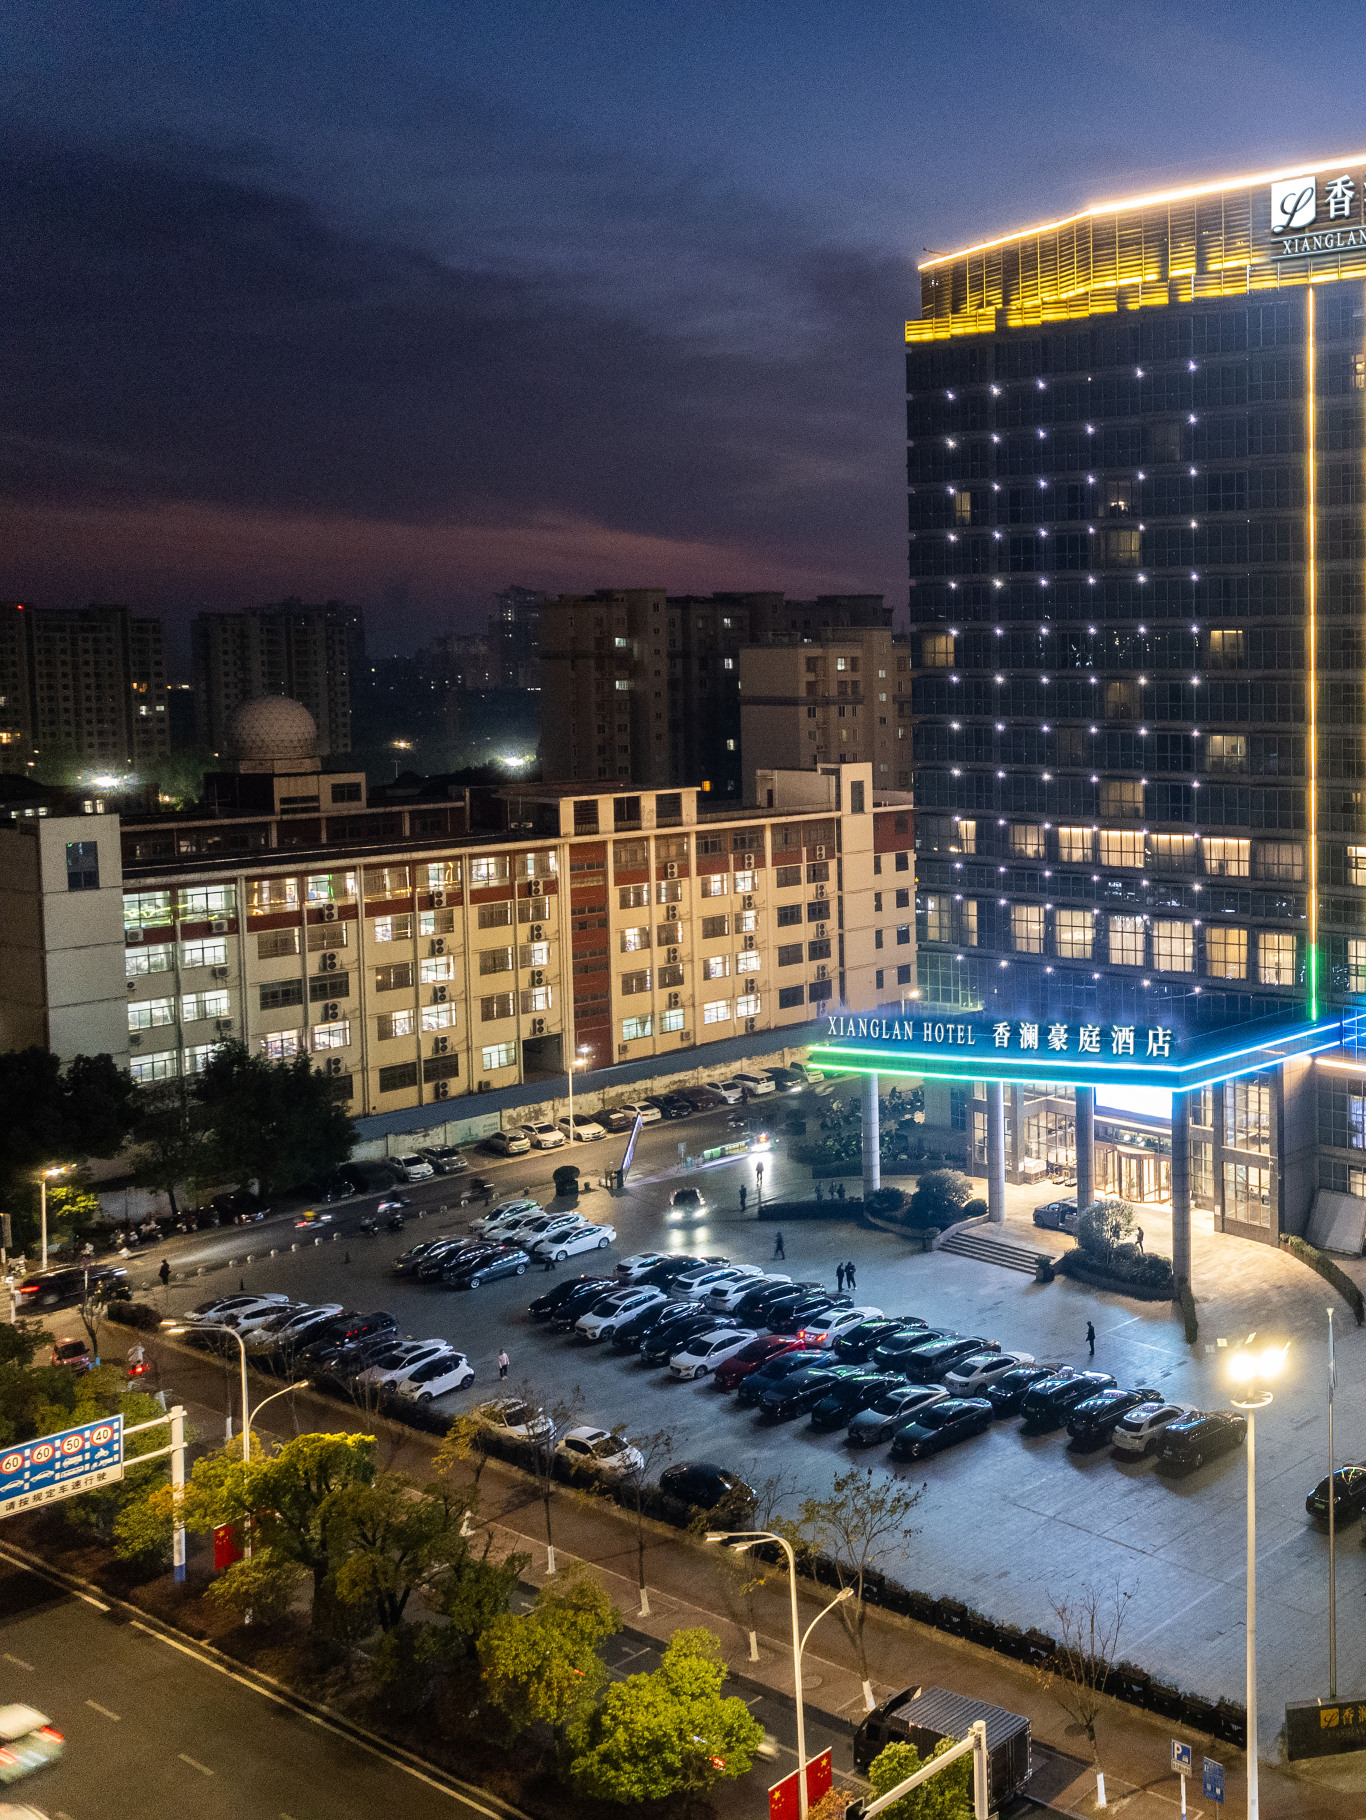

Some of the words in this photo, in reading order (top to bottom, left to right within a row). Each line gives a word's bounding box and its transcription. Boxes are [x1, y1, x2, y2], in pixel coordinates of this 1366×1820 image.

[827, 1016, 914, 1041] XIANGLAN
[923, 1022, 977, 1046] HOTEL
[991, 1021, 1173, 1058] 香澜豪庭酒店
[5, 1456, 19, 1469] 60
[36, 1447, 50, 1460] 60
[66, 1438, 80, 1450] 50
[95, 1429, 109, 1441] 40
[5, 1471, 107, 1512] 请按规定车速行驶
[1174, 1742, 1182, 1760] P
